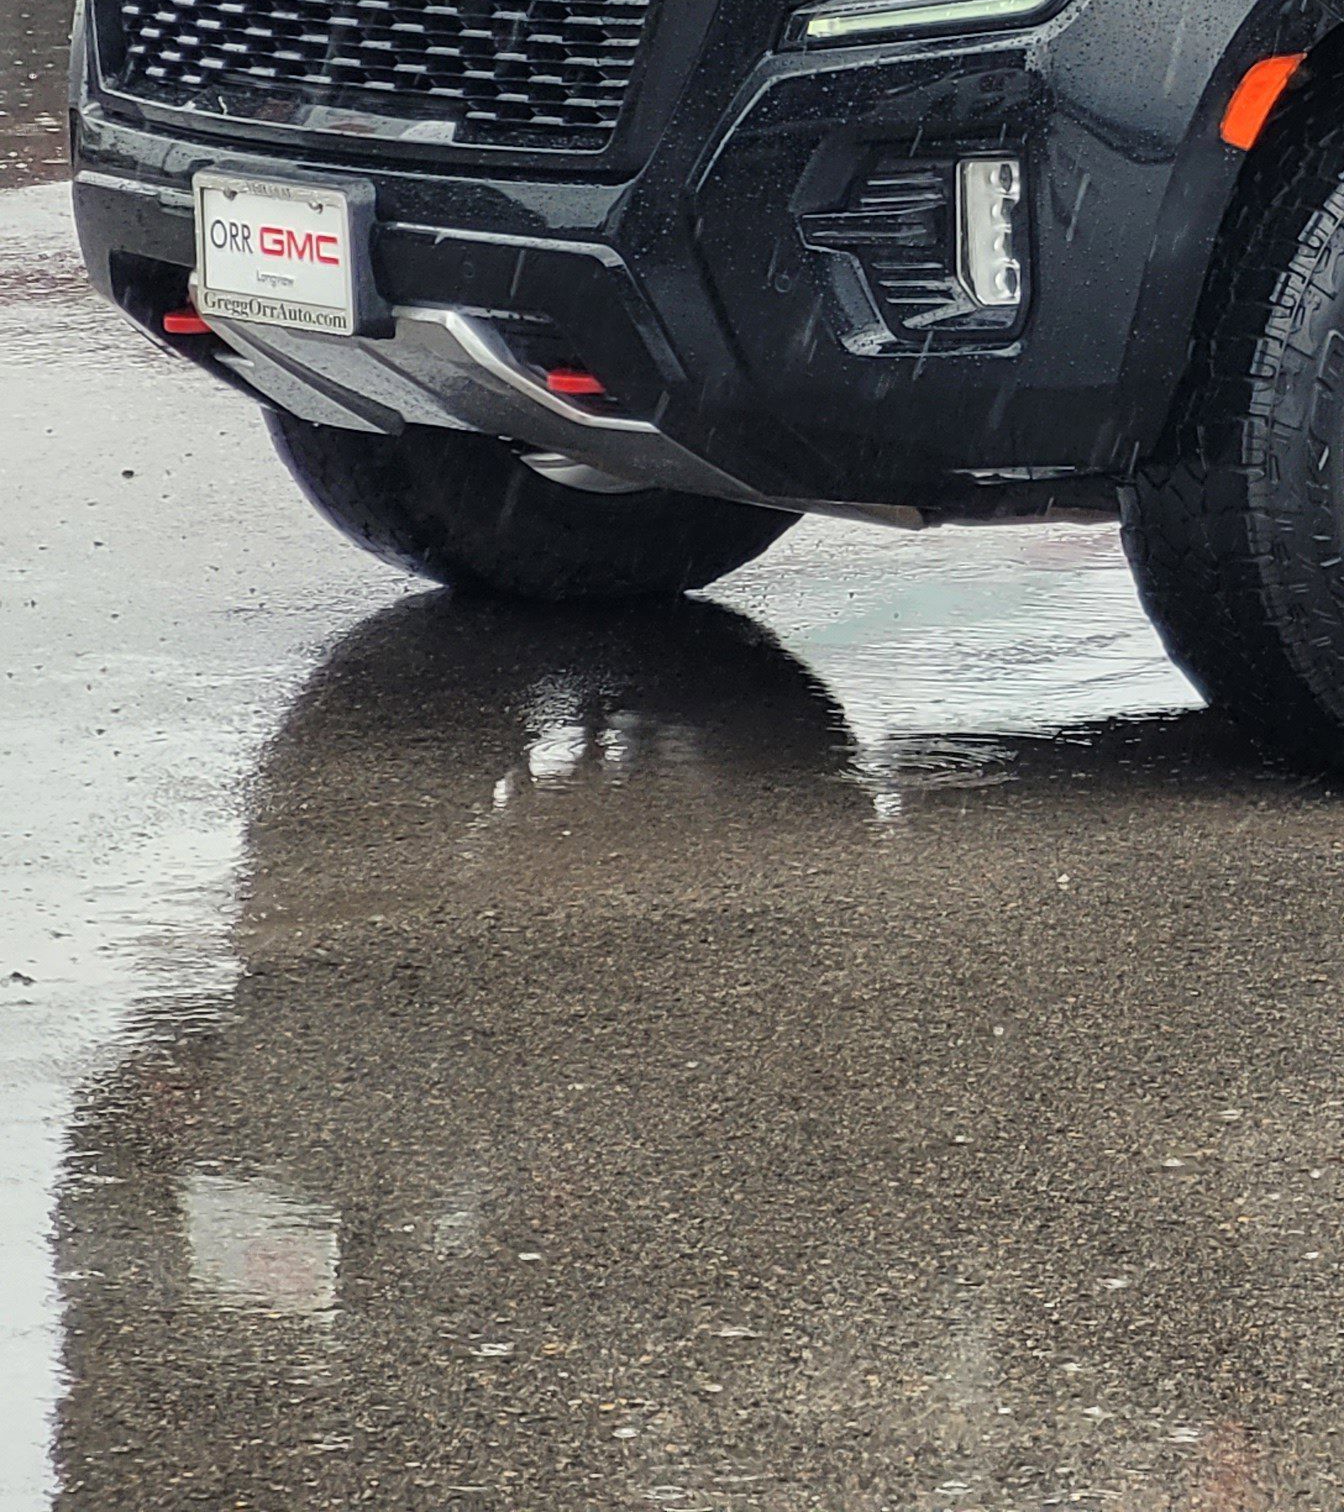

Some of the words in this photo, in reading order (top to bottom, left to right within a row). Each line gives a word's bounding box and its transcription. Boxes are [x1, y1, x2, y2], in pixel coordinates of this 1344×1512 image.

[210, 219, 254, 254] ORR
[259, 226, 340, 266] GMC
[203, 291, 348, 330] GreggOrrAuto.com
